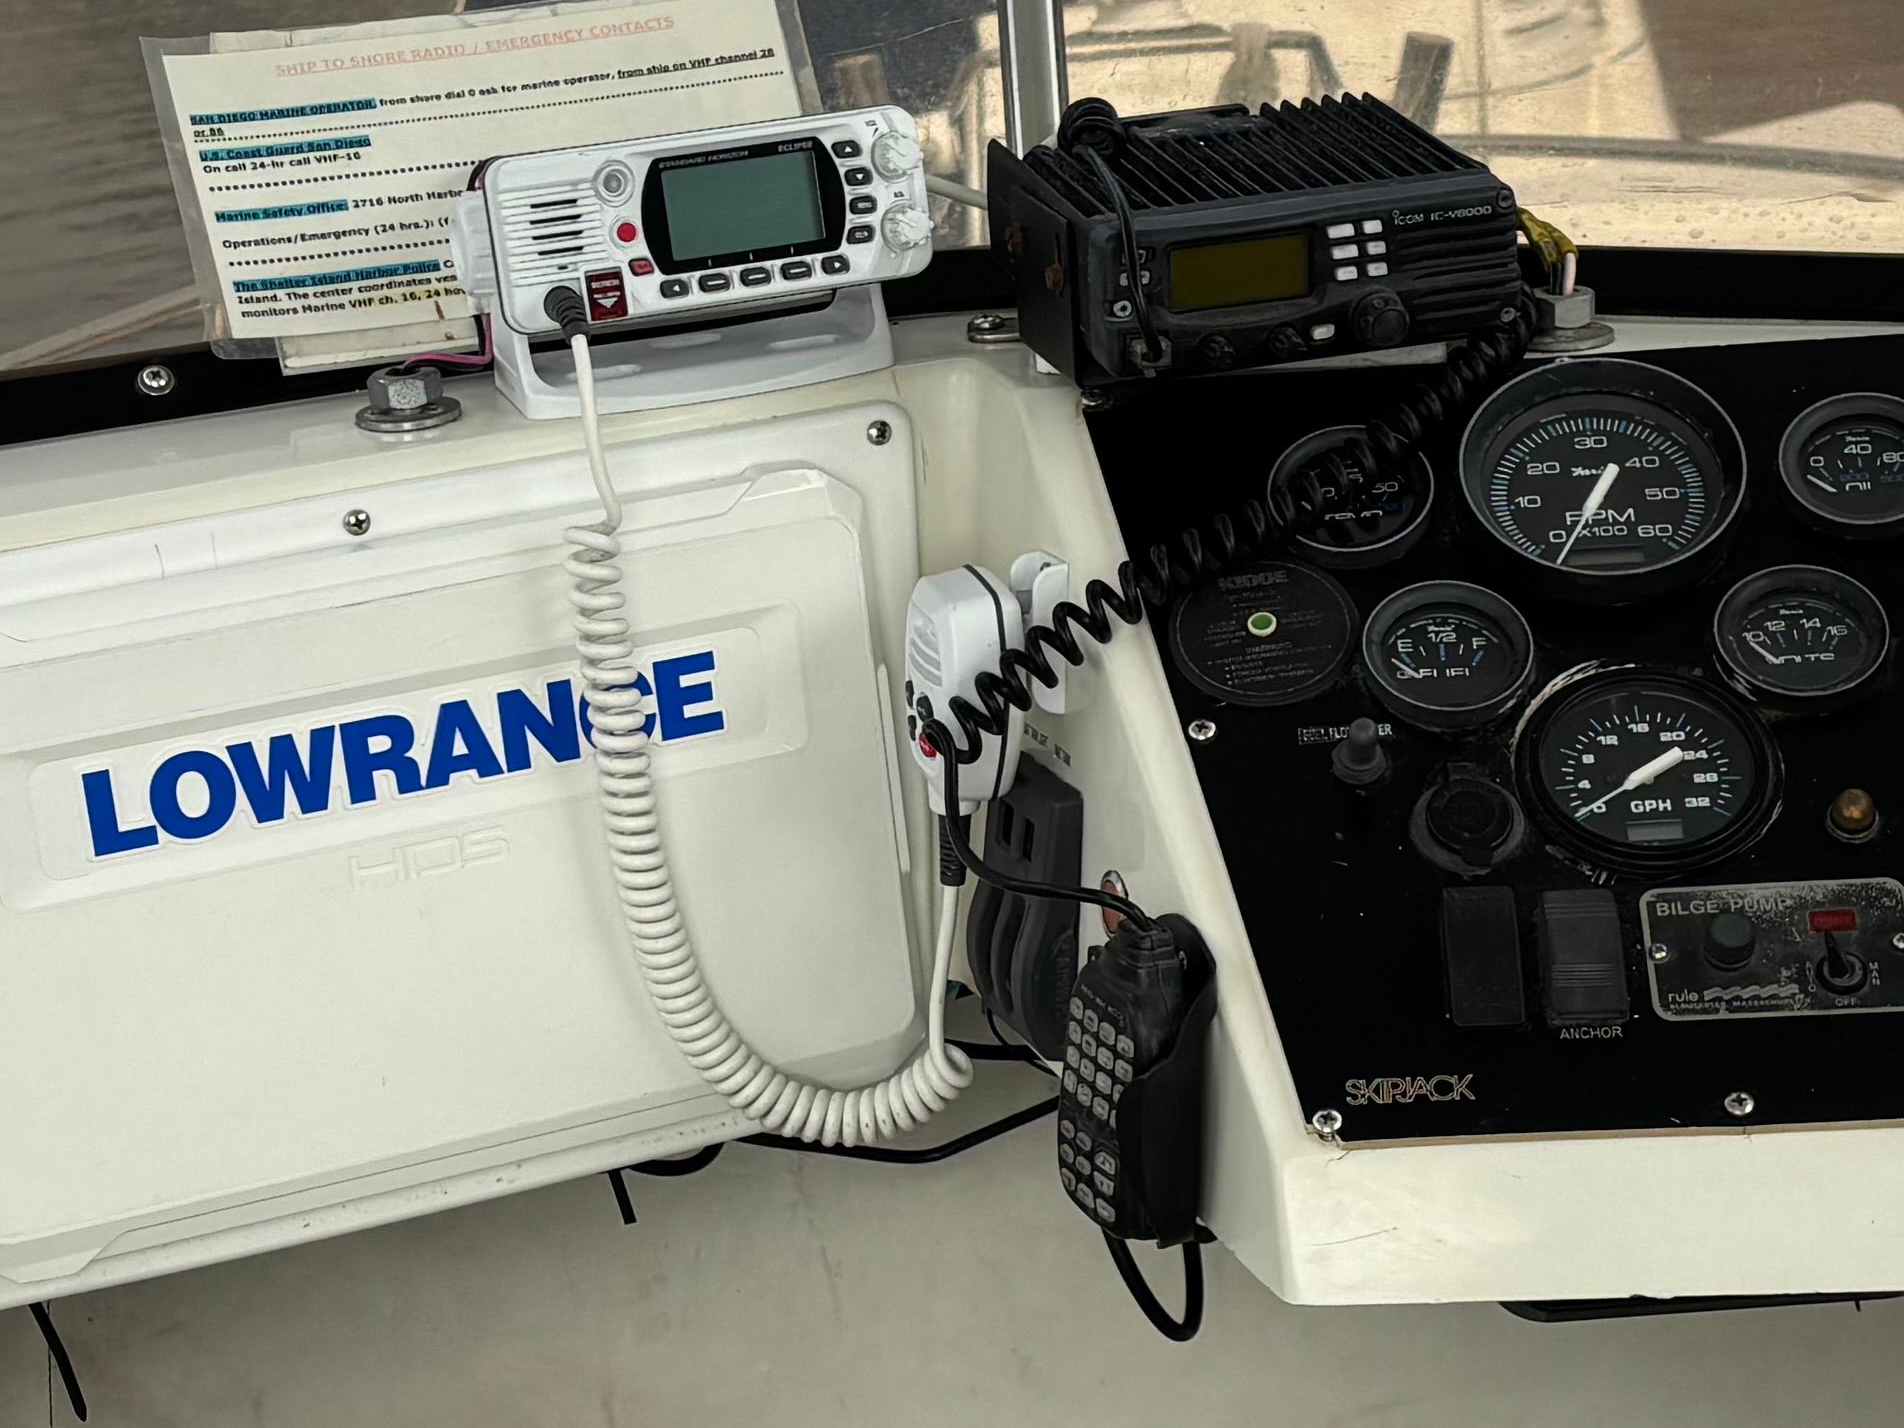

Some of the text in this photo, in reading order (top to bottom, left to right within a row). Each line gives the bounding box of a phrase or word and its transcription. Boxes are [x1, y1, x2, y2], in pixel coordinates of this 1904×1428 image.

[276, 61, 318, 76] SHIP
[323, 58, 346, 73] TO
[351, 50, 407, 70] SHORE
[414, 44, 466, 62] RADIO
[486, 28, 584, 52] EMERGENCY
[590, 16, 675, 39] CONTACTS
[379, 97, 407, 108] from
[410, 92, 442, 104] shore
[445, 89, 466, 100] dial
[478, 85, 499, 97] ask
[501, 83, 518, 94] for
[521, 79, 561, 91] marine
[617, 67, 645, 80] from
[647, 62, 670, 75] ship
[672, 60, 687, 72] on
[689, 57, 712, 70] VHF
[714, 50, 758, 66] channel
[226, 144, 262, 159] Coast
[265, 140, 304, 156] Guard
[307, 138, 331, 151] San
[334, 135, 371, 150] Diego
[707, 150, 749, 164] HORIZON
[203, 164, 222, 174] On
[225, 161, 247, 173] call
[289, 155, 311, 168] call
[215, 209, 260, 223] Marine
[262, 205, 303, 220] Safety
[387, 192, 424, 206] North
[222, 225, 371, 251] Operations/Emergency
[374, 222, 397, 237] (24
[233, 279, 258, 293] The
[260, 275, 307, 290] Shelter
[310, 270, 351, 286] Island
[237, 291, 283, 306] Island.
[286, 288, 310, 302] The
[312, 285, 353, 300] center
[357, 277, 432, 295] coordinates
[241, 304, 299, 320] monitors
[301, 300, 346, 315] Marine
[348, 296, 375, 310] VHF
[426, 288, 441, 300] 24
[1573, 436, 1608, 449] 30
[1843, 443, 1872, 454] 40
[1526, 462, 1560, 475] 20
[1625, 456, 1660, 468] 40
[1645, 487, 1680, 500] 50
[1514, 495, 1541, 508] 10
[1549, 529, 1566, 543] 0
[1637, 524, 1673, 537] 60
[1764, 620, 1786, 631] 12
[1800, 618, 1821, 628] 14
[1427, 632, 1457, 642] 1/2
[1742, 631, 1764, 642] 10
[1827, 625, 1848, 636] 16
[1397, 639, 1414, 652] E
[1472, 637, 1487, 649] F
[1627, 723, 1650, 733] 16
[1596, 735, 1619, 746] 12
[1659, 731, 1686, 741] 20
[1581, 754, 1595, 764] 8
[1683, 750, 1709, 760] 24
[1577, 780, 1592, 789] 4
[1630, 799, 1672, 813] GPH
[1684, 796, 1711, 808] 32
[348, 825, 511, 893] HDS
[1656, 896, 1793, 917] BILGE PUMP
[1668, 988, 1699, 1003] rule
[1560, 1026, 1623, 1039] ANCHOR
[1345, 1074, 1476, 1105] SKIPJACK
